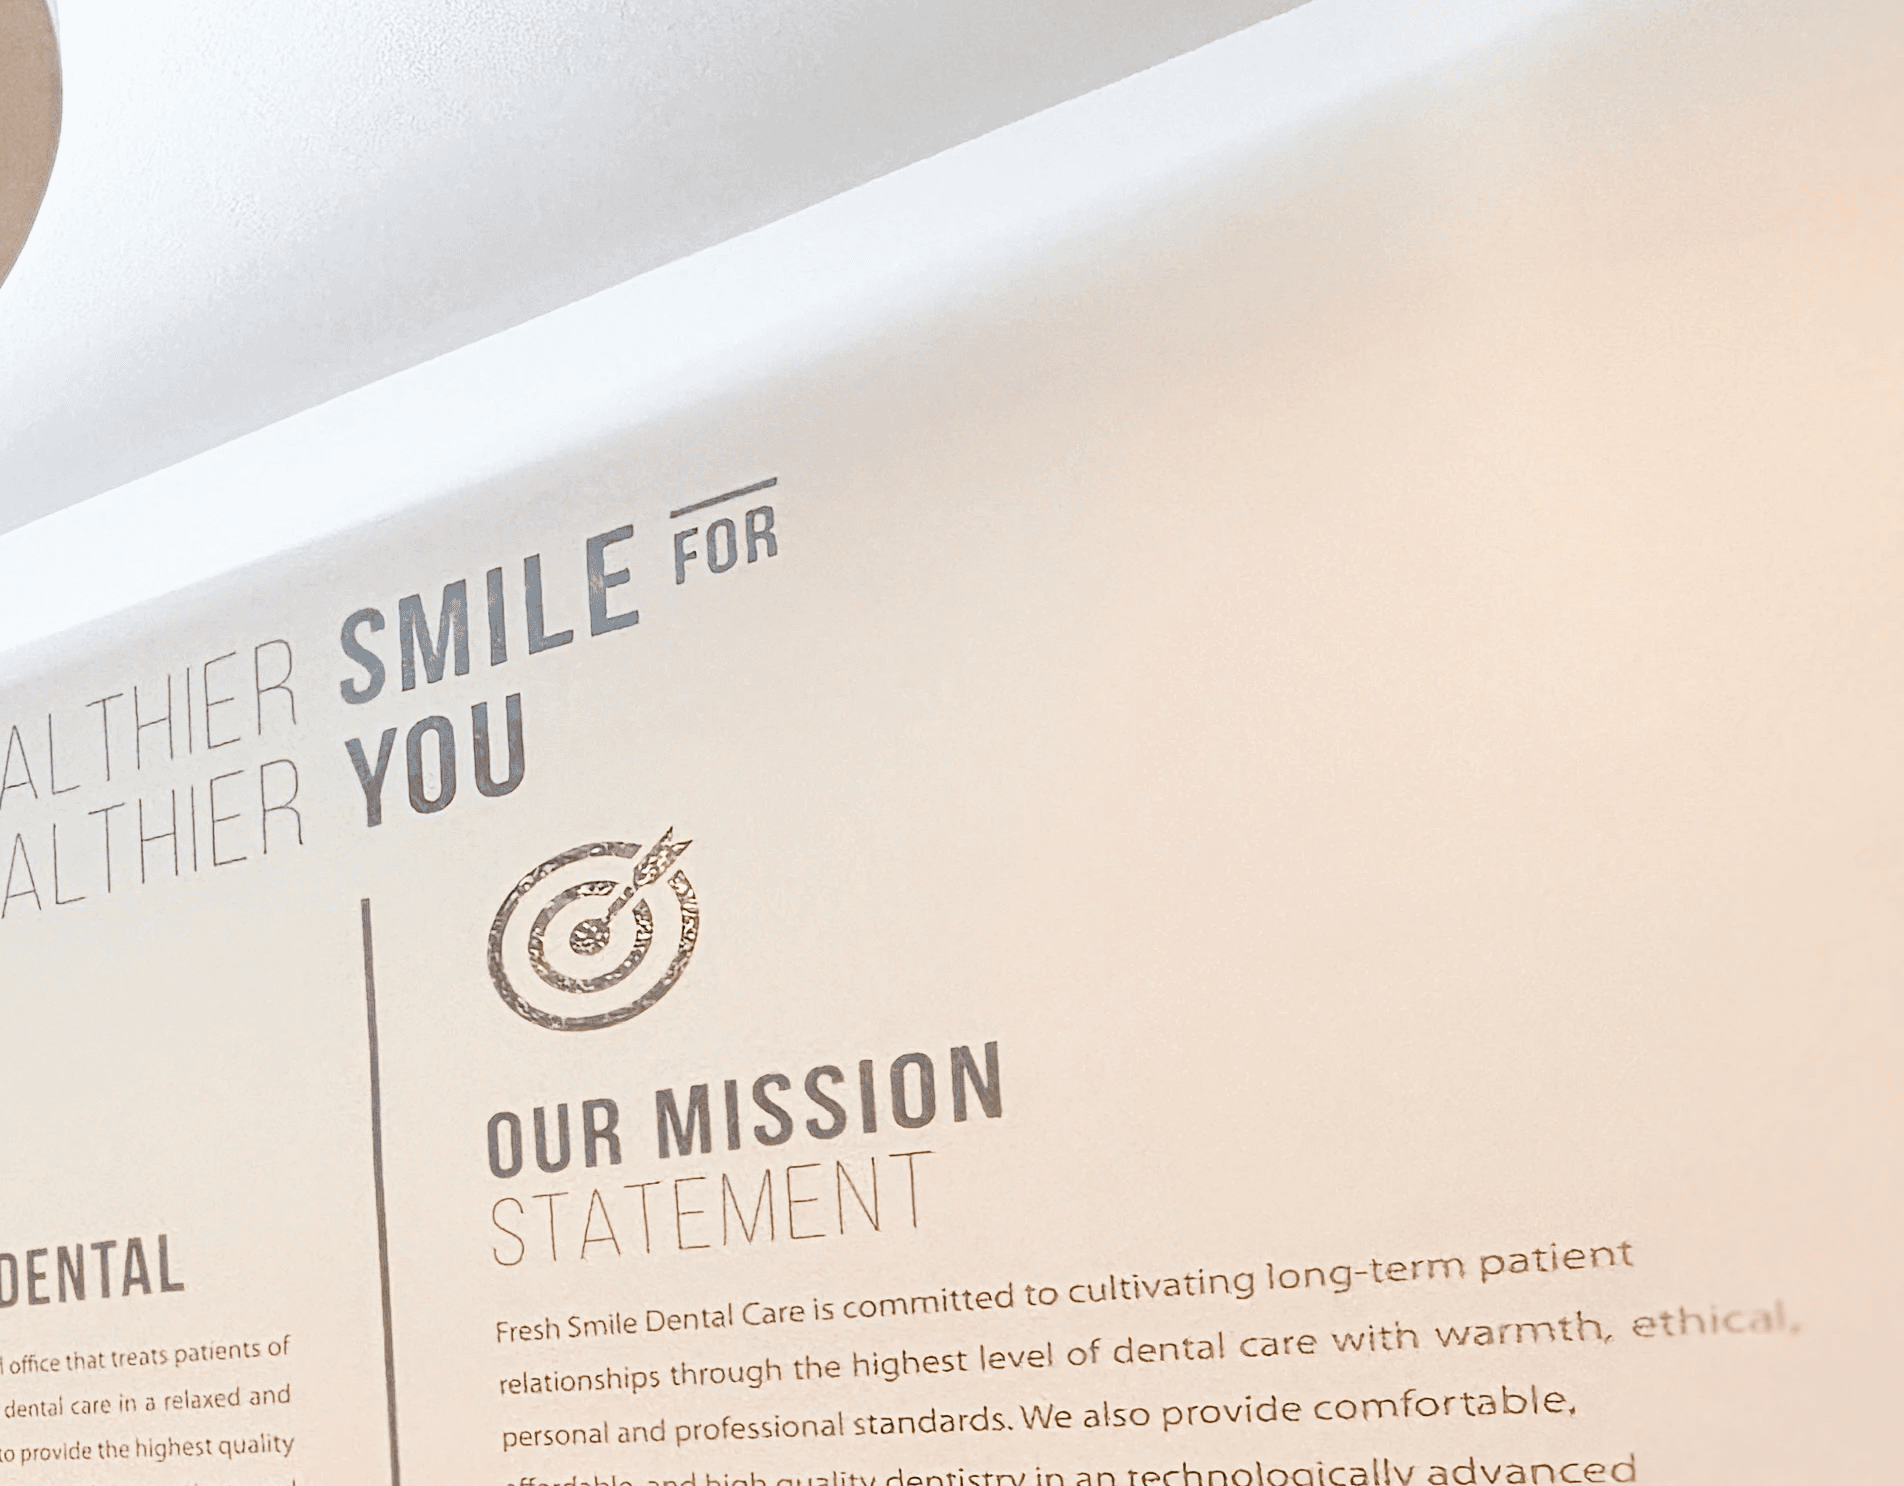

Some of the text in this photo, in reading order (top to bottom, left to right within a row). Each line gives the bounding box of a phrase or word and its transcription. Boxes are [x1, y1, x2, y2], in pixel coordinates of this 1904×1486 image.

[339, 523, 640, 706] SMILE
[669, 504, 778, 586] FOR
[340, 692, 526, 828] YOU
[486, 1040, 1003, 1179] OUR MISSION
[490, 1149, 934, 1267] STATEMENT
[495, 1241, 1634, 1344] Fresh Smile Dental Care is committed to cultivating long-term patient
[8, 1353, 61, 1375] office
[65, 1351, 106, 1372] that
[110, 1348, 169, 1368] treats
[174, 1341, 261, 1369] patients
[267, 1333, 291, 1357] of
[499, 1301, 1801, 1395] relationships through the highest level of dental care with warmth, ethical,
[3, 1395, 64, 1419] dental
[70, 1398, 112, 1416] care
[118, 1393, 137, 1413] in
[145, 1396, 156, 1412] a
[164, 1386, 241, 1411] relaxed
[249, 1382, 291, 1406] and
[502, 1384, 1576, 1453] personal and professional standards. We also provide comfortable,
[20, 1440, 93, 1467] provide
[97, 1439, 130, 1460] the
[135, 1436, 213, 1464] highest
[218, 1432, 295, 1460] quality
[1427, 1452, 1636, 1486] advanced
